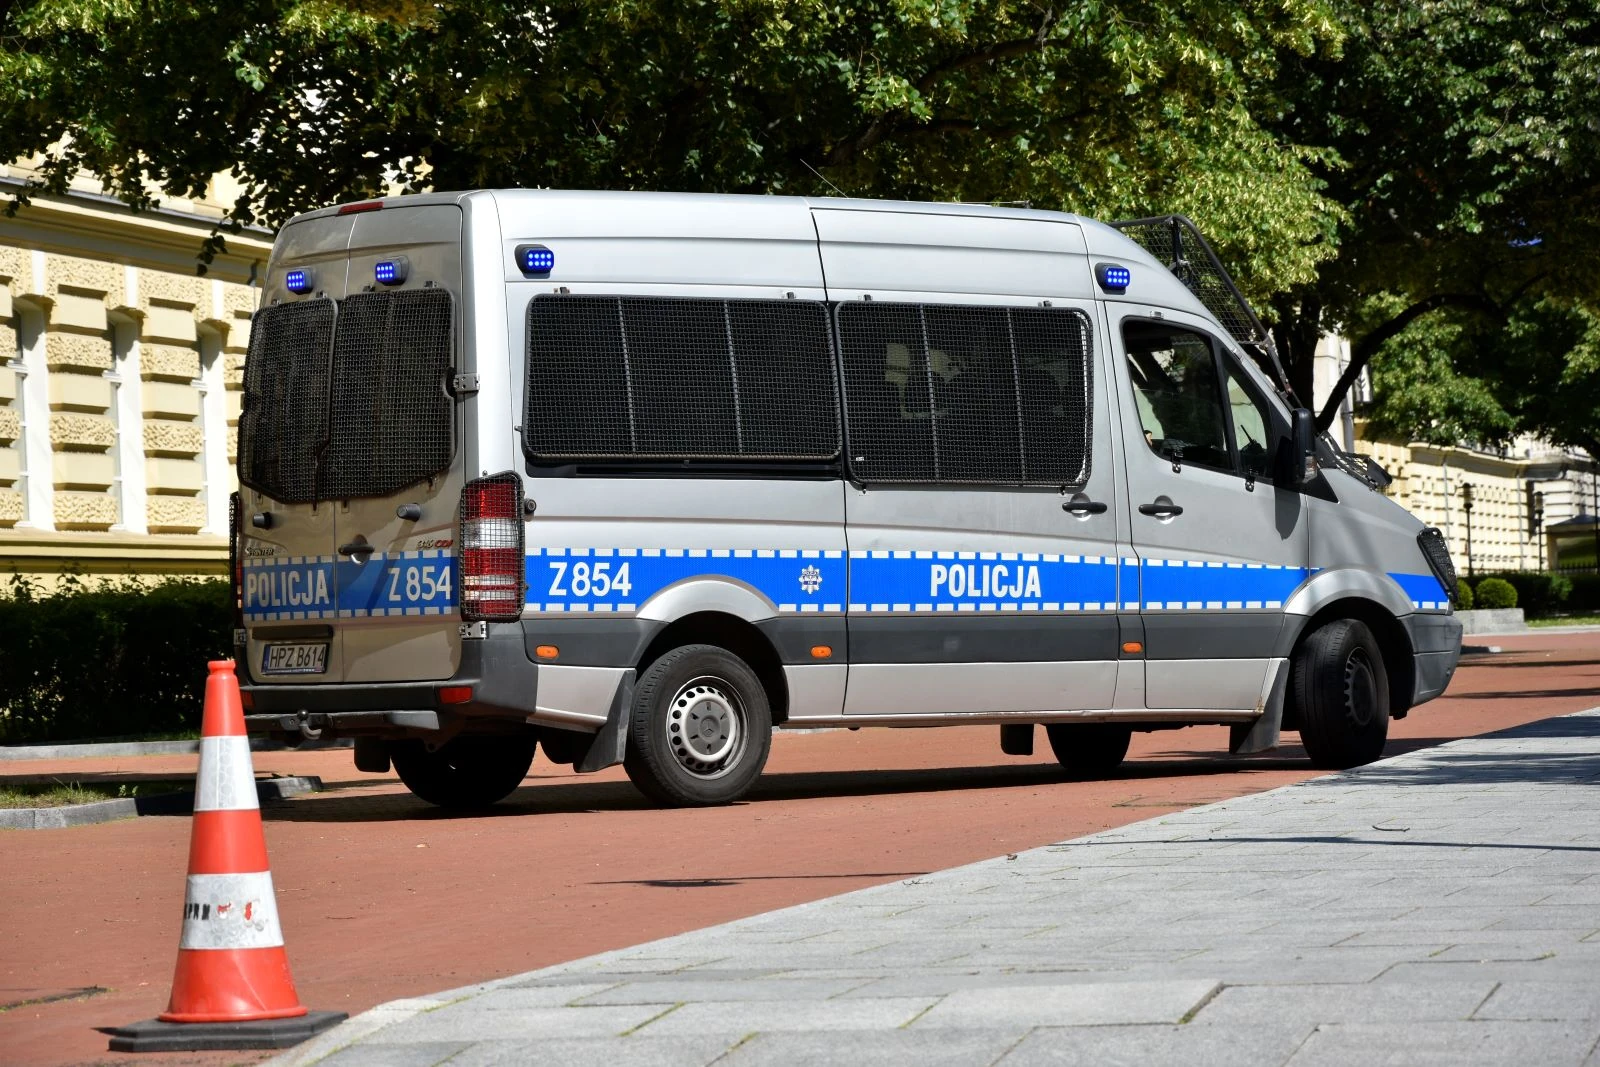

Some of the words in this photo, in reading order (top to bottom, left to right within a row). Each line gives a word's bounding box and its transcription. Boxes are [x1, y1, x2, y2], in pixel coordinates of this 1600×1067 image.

[246, 569, 330, 608] POLICJA
[388, 567, 402, 601] Z
[406, 566, 453, 601] 854
[548, 561, 568, 597] Z
[570, 561, 632, 597] 854
[930, 563, 1042, 599] POLICJA
[269, 648, 294, 667] HPZ
[296, 646, 326, 667] B614
